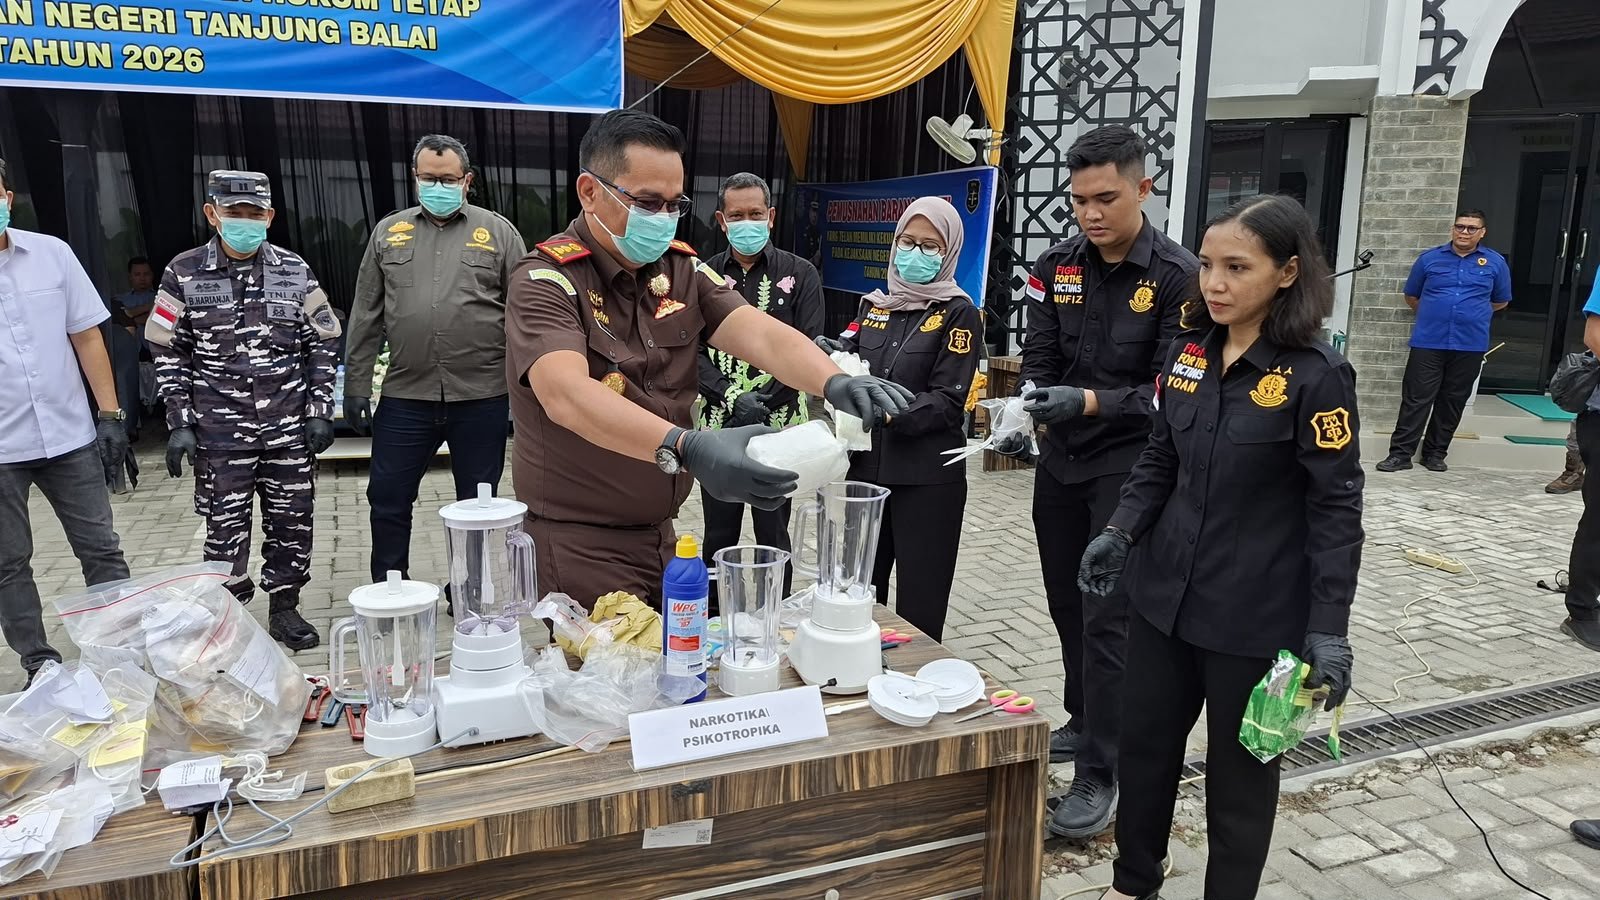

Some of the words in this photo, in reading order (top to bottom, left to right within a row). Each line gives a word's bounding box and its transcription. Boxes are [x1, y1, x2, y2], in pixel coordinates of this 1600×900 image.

[45, 1, 177, 34] NEGERI
[184, 9, 341, 44] TANJUNG
[350, 20, 438, 50] BALAI
[122, 44, 205, 73] 2026
[1056, 265, 1084, 275] FIGHT
[268, 291, 287, 299] TNI
[862, 319, 887, 330] DIAN
[1177, 352, 1197, 367] FOR
[1171, 361, 1205, 380] VICTIMS
[1166, 374, 1198, 394] YOAN
[672, 602, 698, 613] WPC
[683, 723, 781, 748] PSIKOTROPIKA
